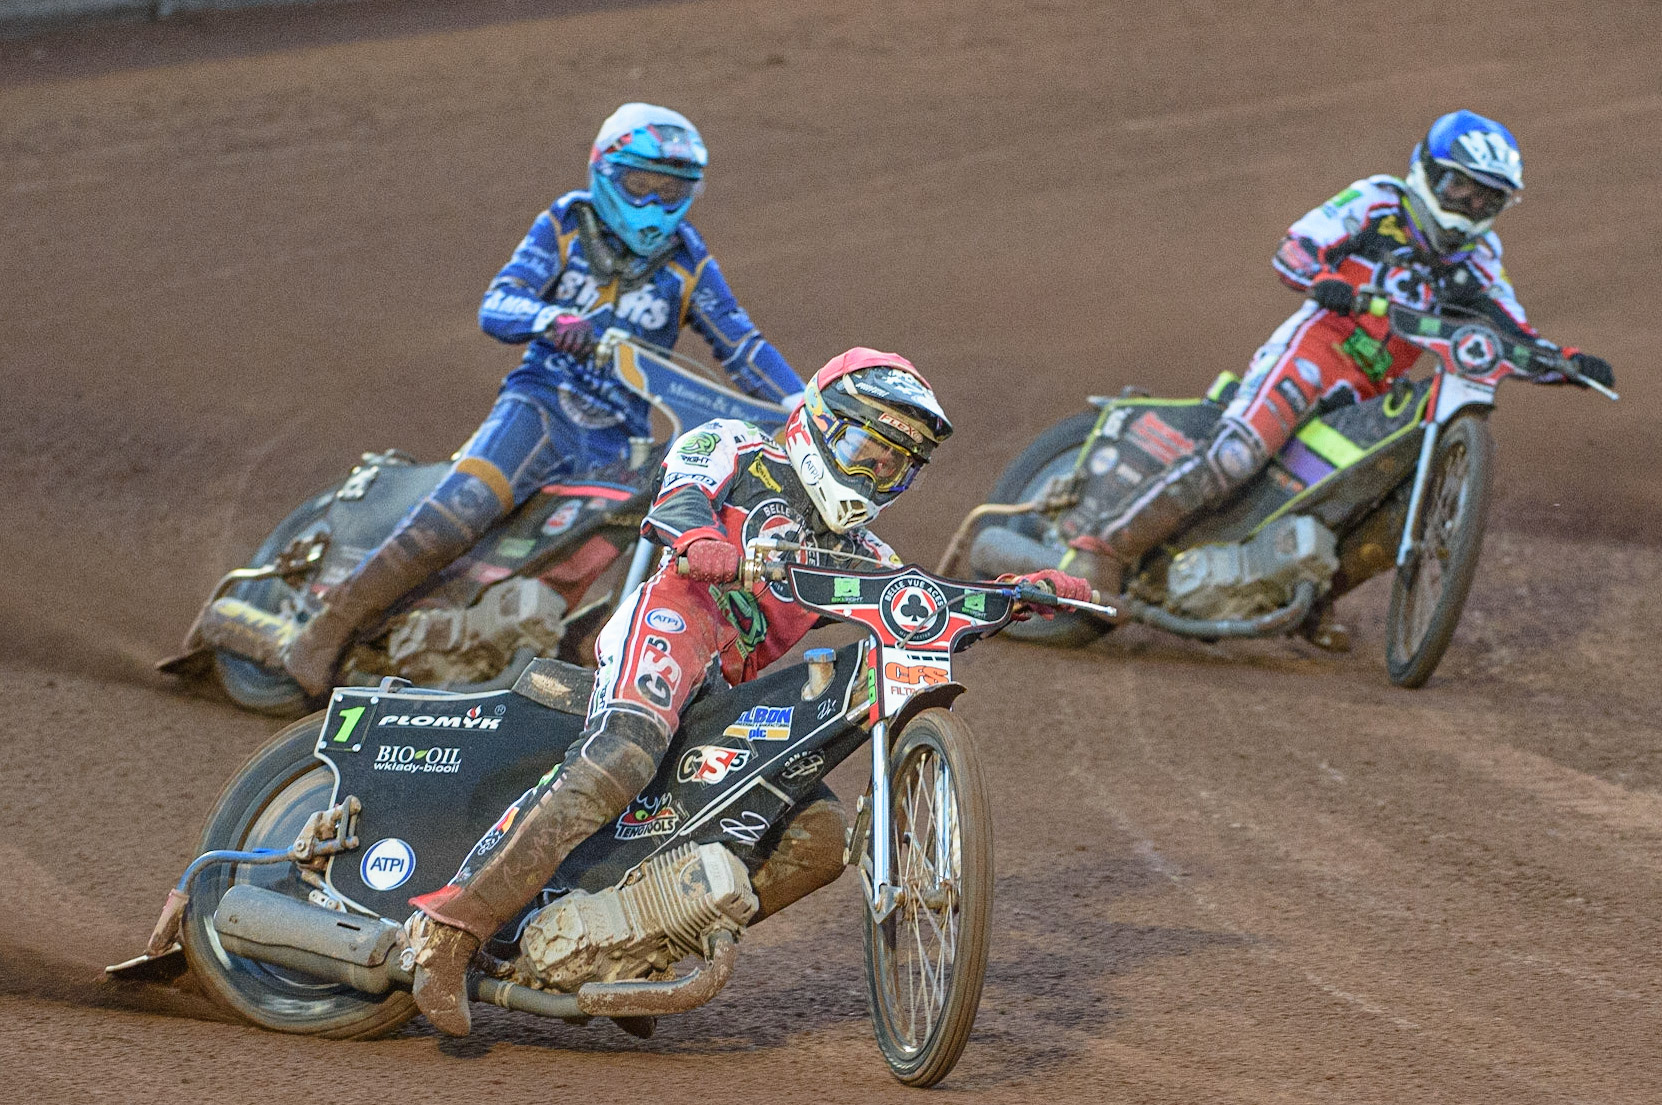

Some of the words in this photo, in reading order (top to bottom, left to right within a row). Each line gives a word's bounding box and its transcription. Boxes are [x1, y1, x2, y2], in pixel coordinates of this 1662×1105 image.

[763, 504, 791, 517] BELLE
[884, 581, 906, 602] BELLE
[908, 578, 926, 588] VUE
[927, 586, 945, 607] ACES
[653, 614, 679, 626] ATPI
[885, 661, 949, 685] CFS
[333, 706, 365, 742] 1
[748, 727, 767, 739] plc
[370, 855, 404, 873] ATPI
